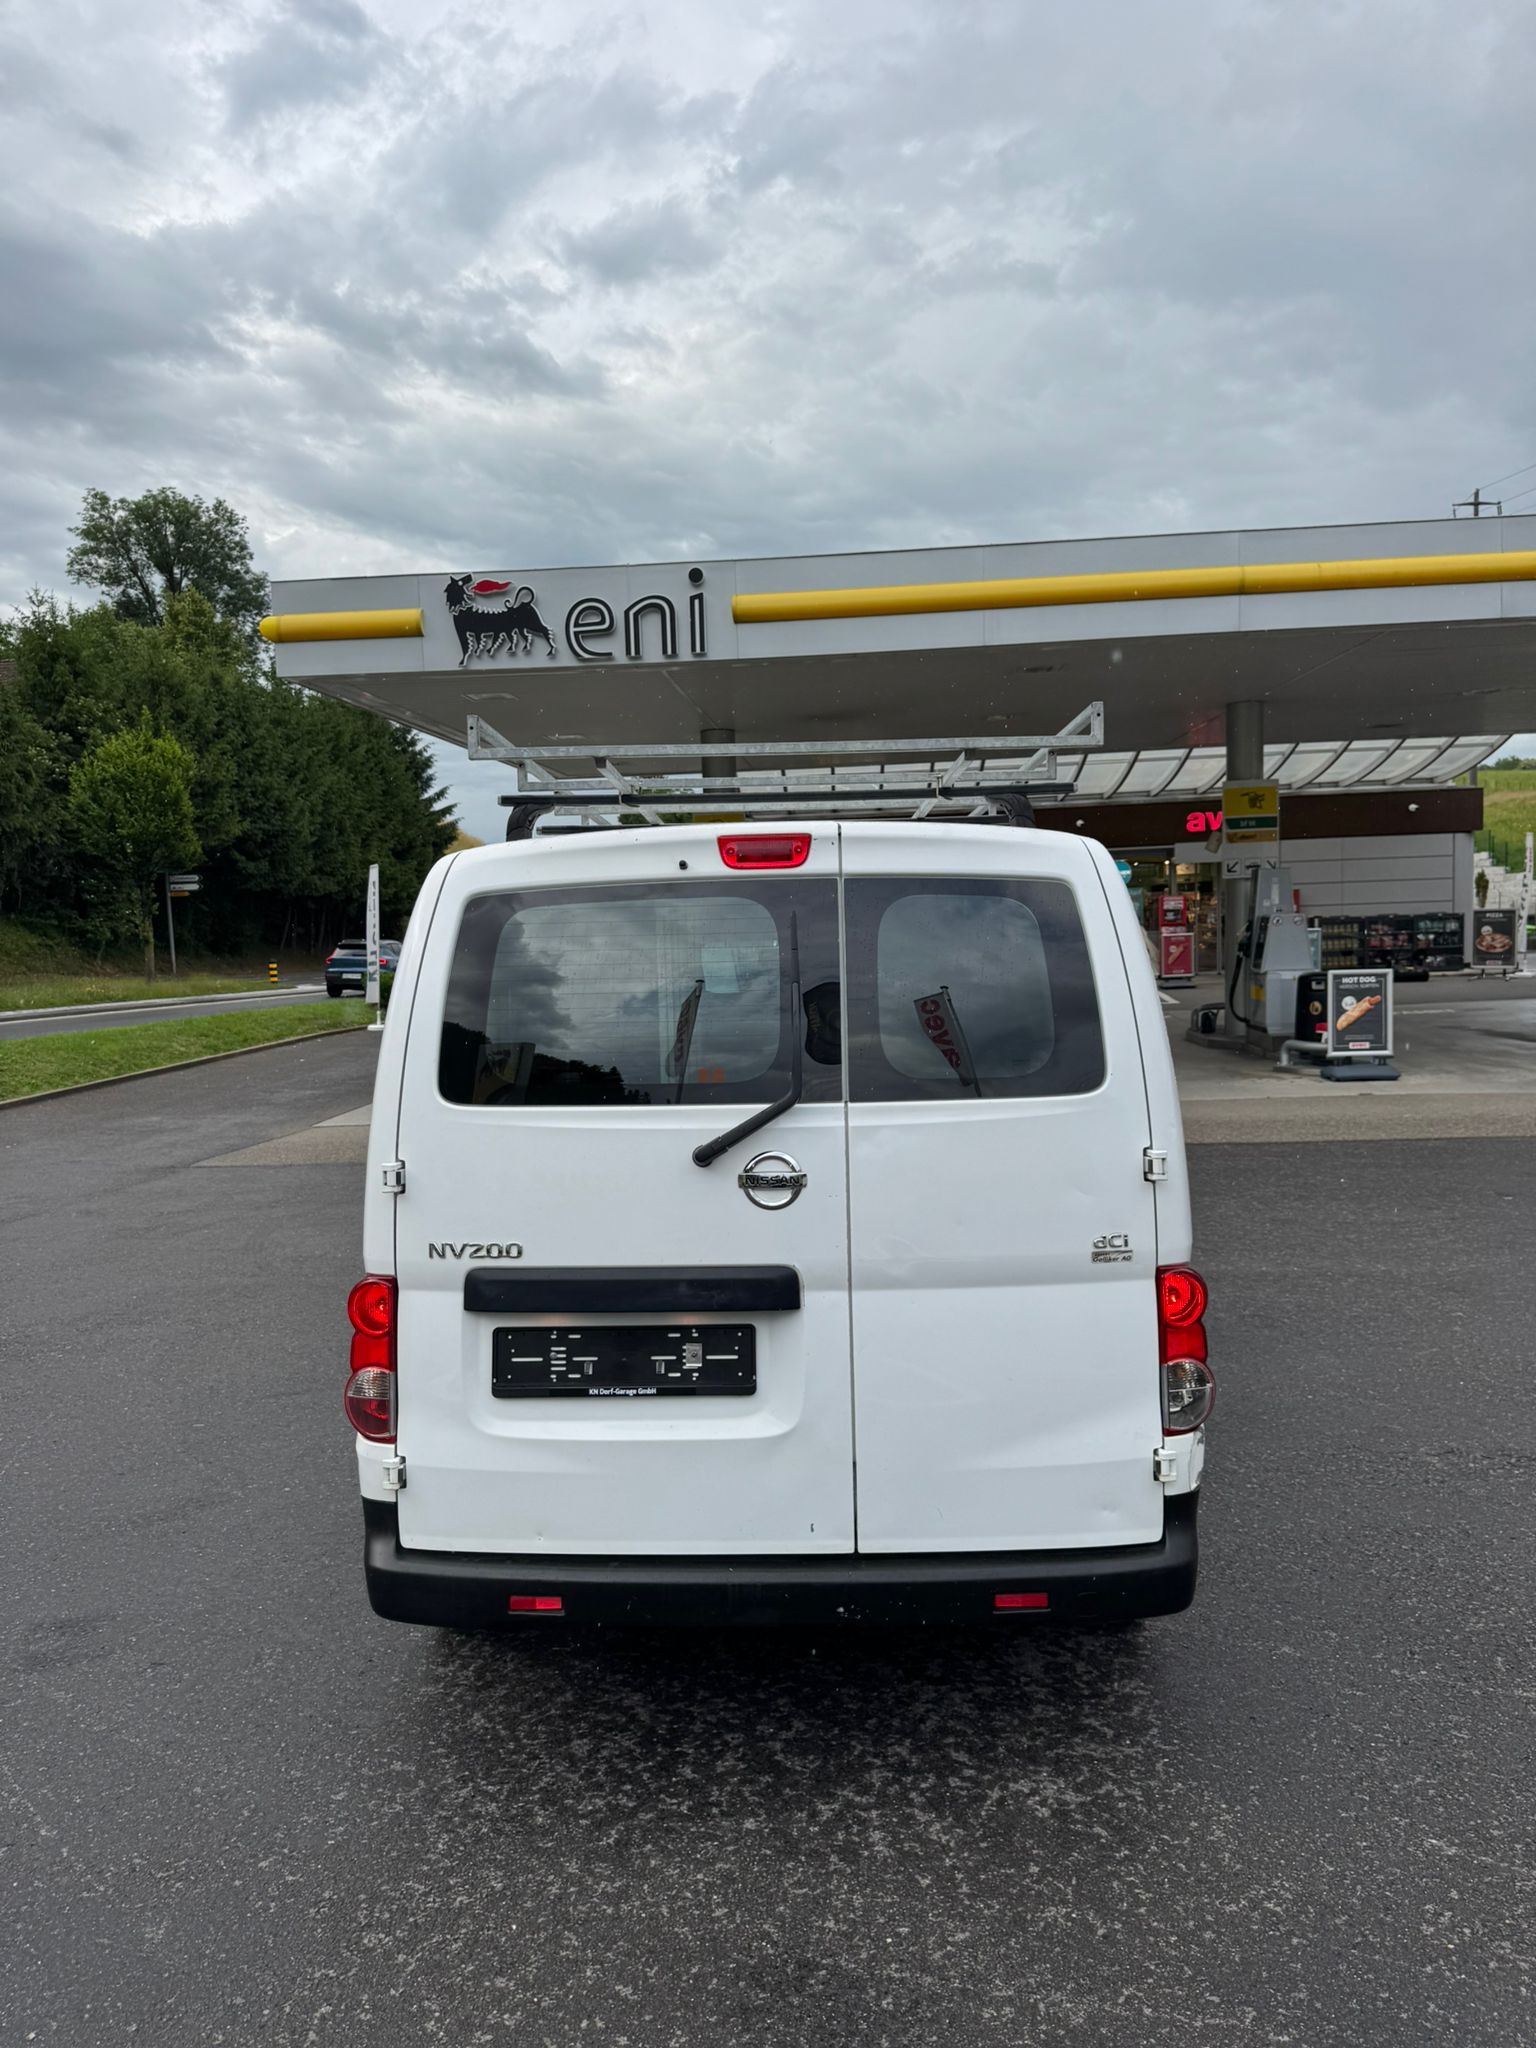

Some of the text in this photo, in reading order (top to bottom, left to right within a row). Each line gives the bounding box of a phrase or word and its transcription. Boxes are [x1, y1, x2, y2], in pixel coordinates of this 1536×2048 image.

[565, 566, 707, 659] eni
[1186, 811, 1223, 832] av
[745, 1175, 800, 1185] NISSAN
[1093, 1233, 1129, 1249] dCi
[428, 1241, 523, 1260] NV200
[599, 1387, 637, 1396] Dorf-Garage
